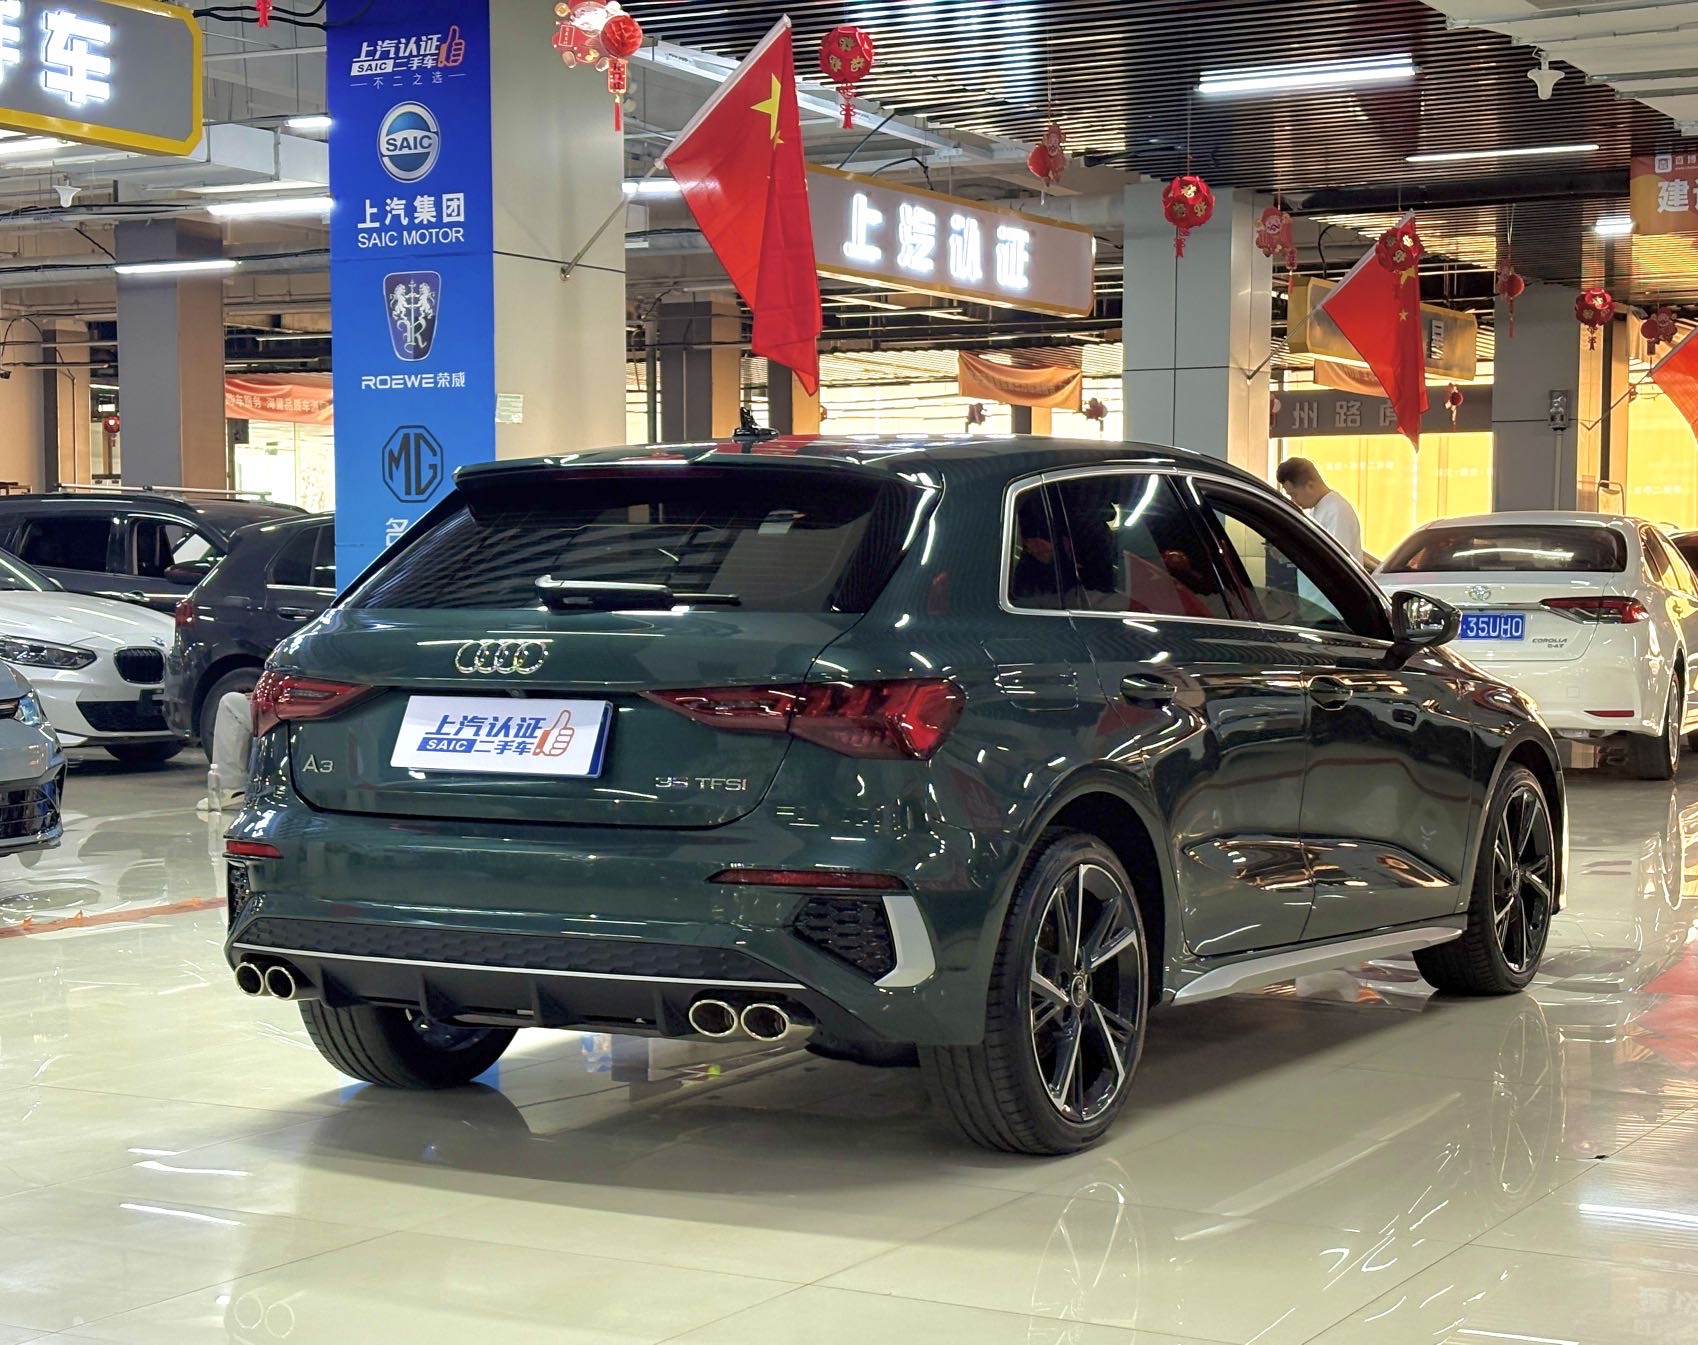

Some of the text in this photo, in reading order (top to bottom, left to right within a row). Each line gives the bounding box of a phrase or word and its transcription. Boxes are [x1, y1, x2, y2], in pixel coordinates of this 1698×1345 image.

[353, 34, 441, 61] 上汽认证
[356, 62, 388, 73] SAIC
[393, 55, 438, 71] 二手车
[373, 71, 443, 89] 不二之选
[385, 135, 433, 152] SAIC
[1657, 179, 1698, 213] 建
[358, 192, 465, 229] 上汽集团
[358, 227, 465, 248] SAIC MOTOR
[842, 192, 1031, 290] 上汽认证
[361, 371, 466, 390] ROEWE 荣威
[387, 432, 438, 496] MG
[425, 714, 546, 739] 上汽认证
[426, 739, 468, 751] SAIC
[473, 739, 535, 755] 二手车
[302, 754, 333, 773] A3
[695, 778, 747, 791] TFSI
